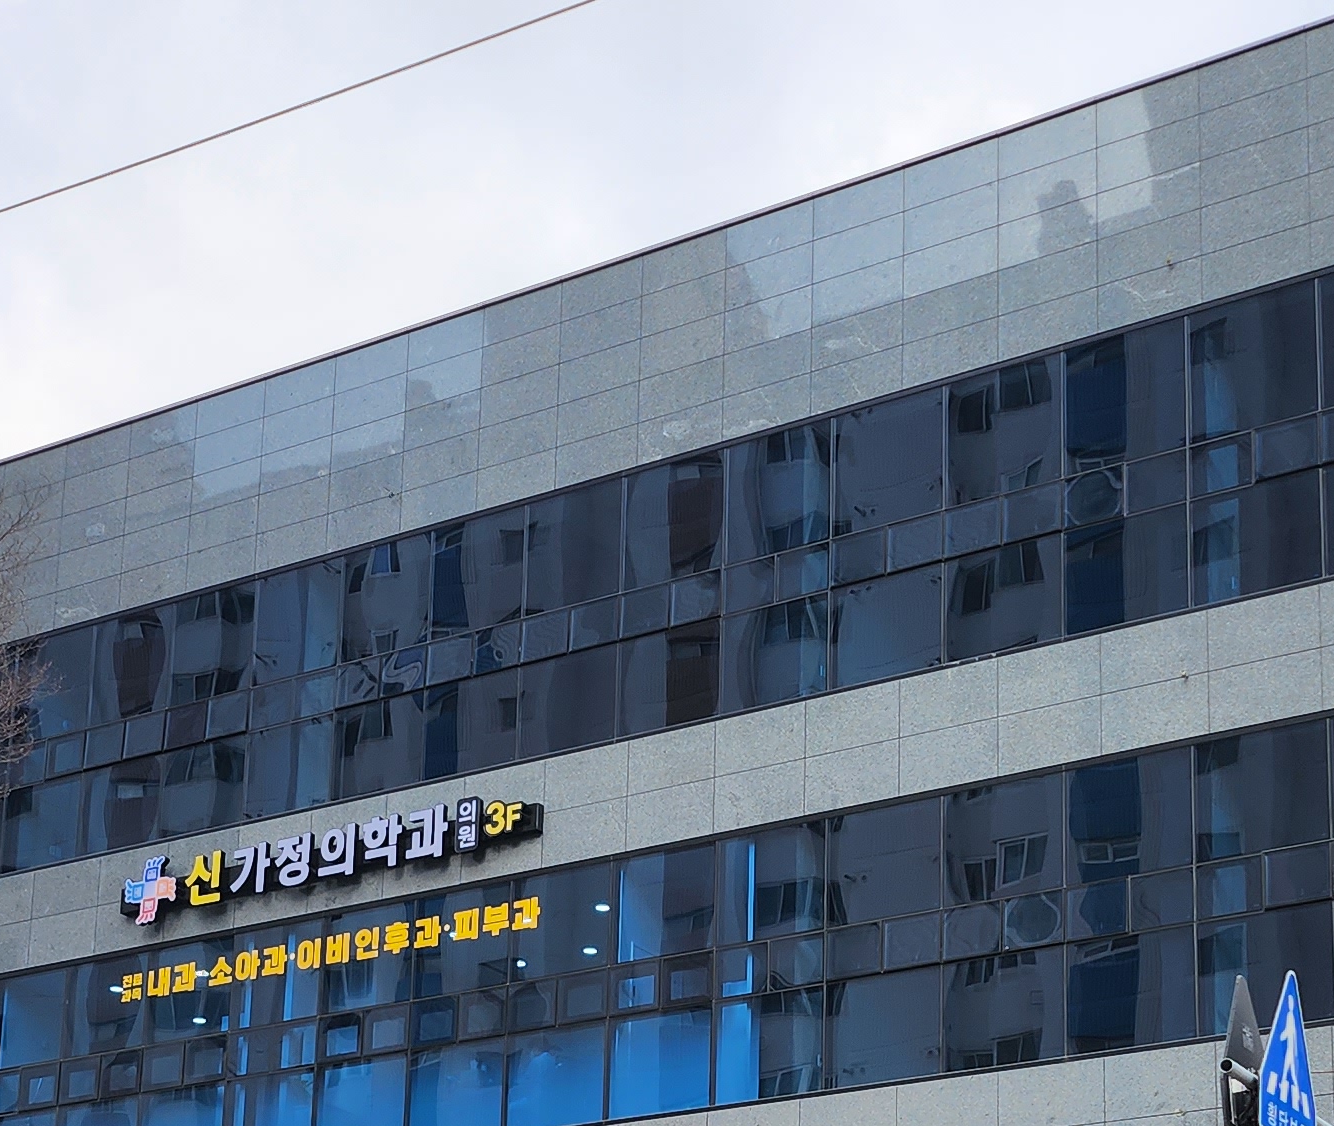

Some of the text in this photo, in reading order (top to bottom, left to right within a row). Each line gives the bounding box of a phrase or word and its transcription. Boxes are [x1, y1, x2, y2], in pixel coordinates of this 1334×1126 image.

[184, 799, 523, 906] 신 가정의학과 의원 3F
